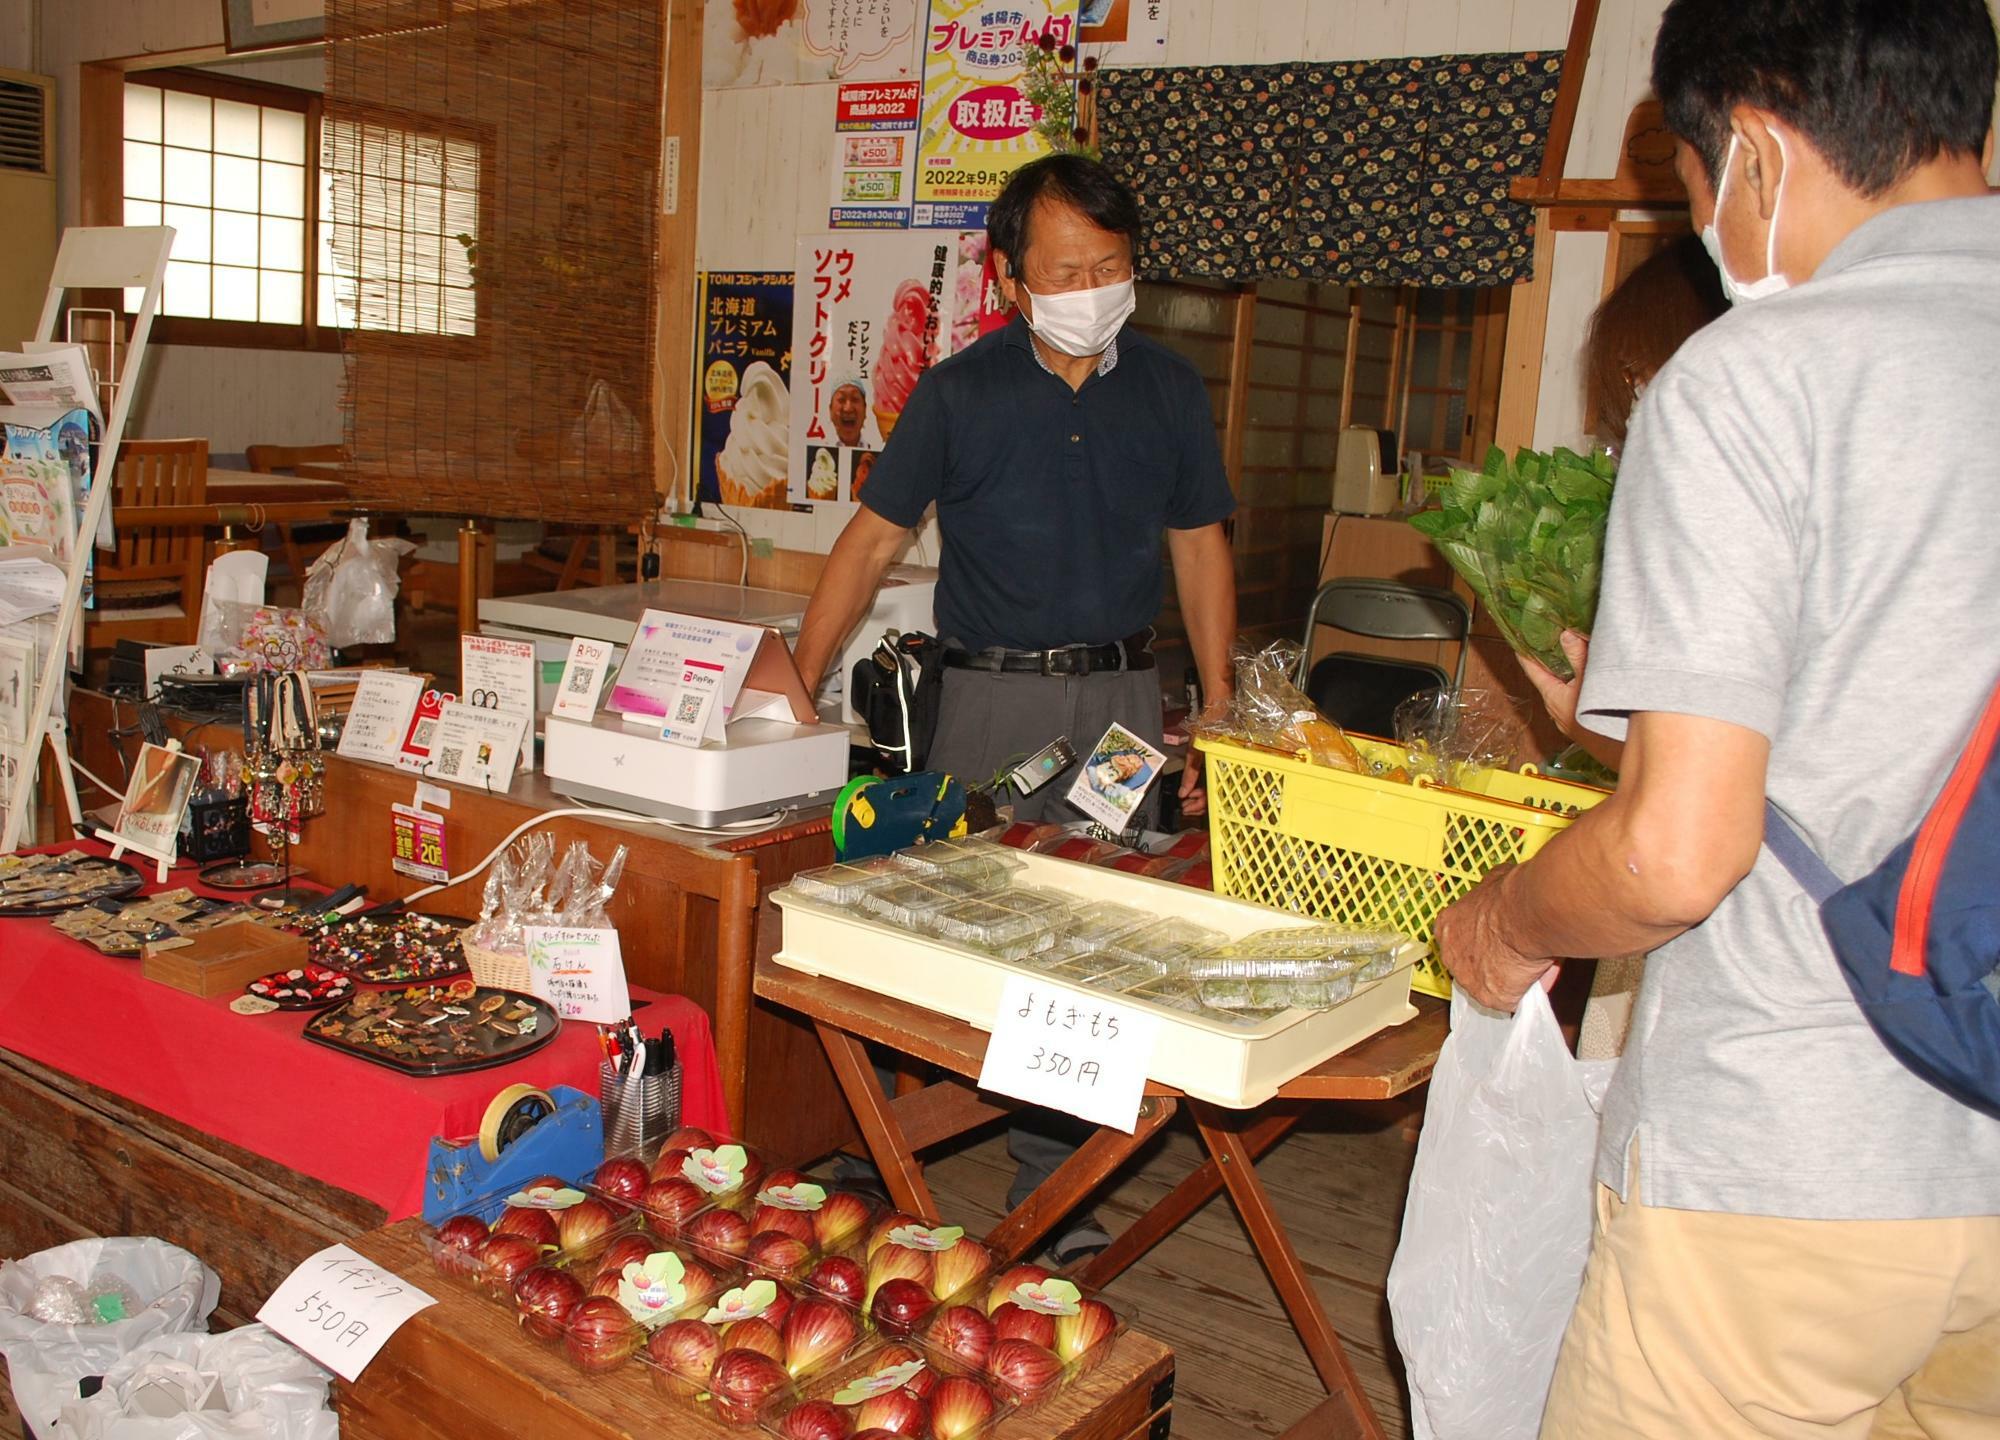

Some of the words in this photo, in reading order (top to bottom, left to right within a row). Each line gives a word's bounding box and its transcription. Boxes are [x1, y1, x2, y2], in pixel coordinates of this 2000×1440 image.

[880, 0, 891, 38] らいを
[933, 14, 1072, 51] プレミアム付
[955, 98, 1035, 129] 取扱店
[834, 248, 855, 304] ウメ
[710, 296, 756, 317] 北海道
[710, 318, 777, 337] プレミアム
[806, 248, 834, 440] ソフトクリーム
[708, 339, 749, 358] バニラ
[858, 320, 871, 379] フレッシュ
[585, 645, 603, 660] Pay
[692, 673, 715, 686] PayPay
[1018, 992, 1119, 1040] よもぎもち
[1026, 1046, 1101, 1086] 350円
[322, 1259, 404, 1299] イチジク
[295, 1290, 369, 1348] 550円
